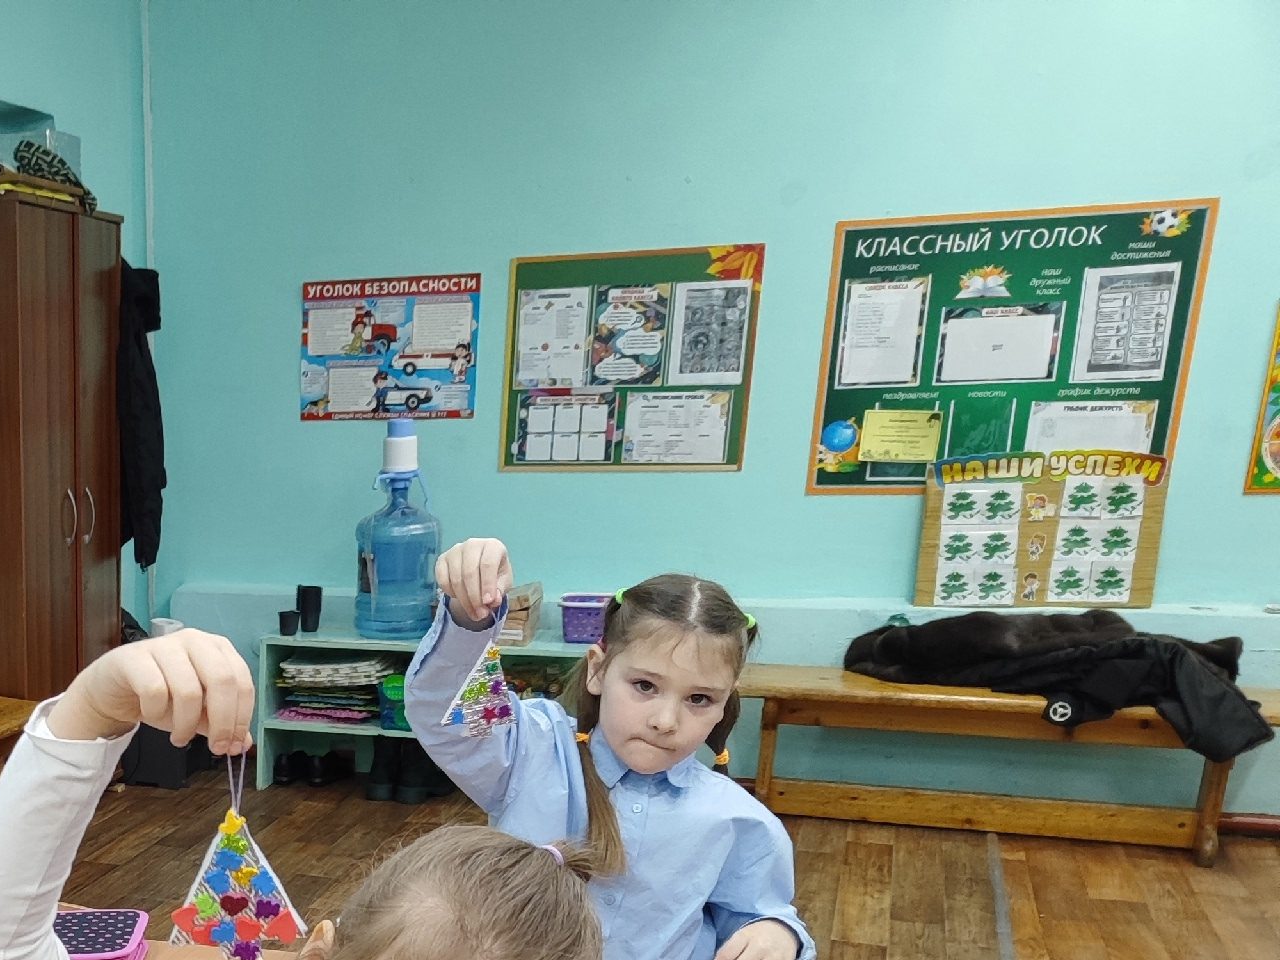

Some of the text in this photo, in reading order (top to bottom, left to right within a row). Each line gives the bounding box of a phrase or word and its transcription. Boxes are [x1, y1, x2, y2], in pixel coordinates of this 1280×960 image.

[855, 223, 1108, 259] КЛАССНЫЙ УГОЛОК
[1110, 249, 1171, 261] достижения
[869, 263, 920, 274] расписание
[1041, 268, 1062, 277] наш
[307, 276, 477, 299] УГОЛОК БЕЗОПАСНОСТИ
[1035, 286, 1062, 296] класс
[968, 390, 1007, 398] новости
[1057, 386, 1141, 398] график дежурств
[941, 454, 1162, 483] НАШИ УСПЕХИ
